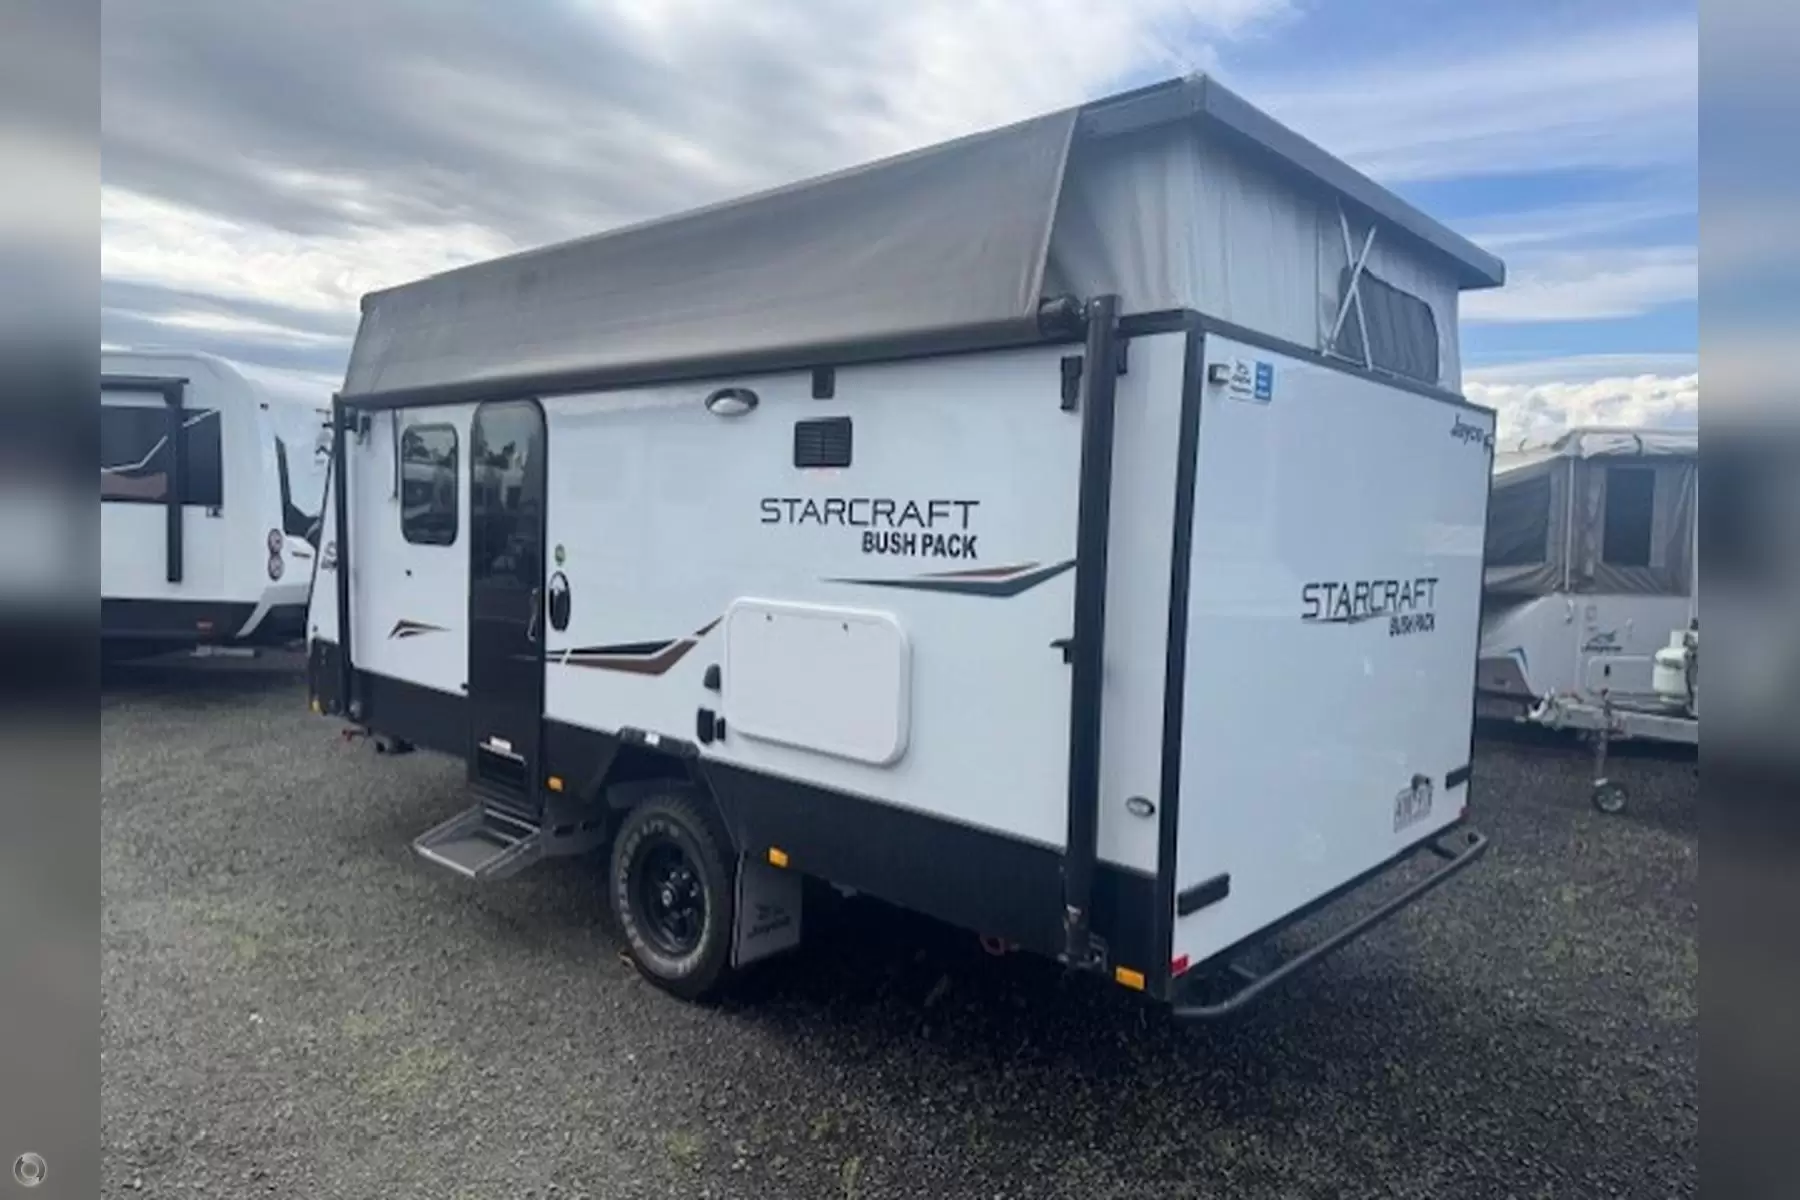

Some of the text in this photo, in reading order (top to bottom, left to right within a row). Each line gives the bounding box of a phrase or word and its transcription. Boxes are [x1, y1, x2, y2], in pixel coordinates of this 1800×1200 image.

[760, 498, 980, 529] STARCRAFT
[862, 531, 978, 560] BUSH PACK
[1301, 578, 1439, 619] STARCRAFT
